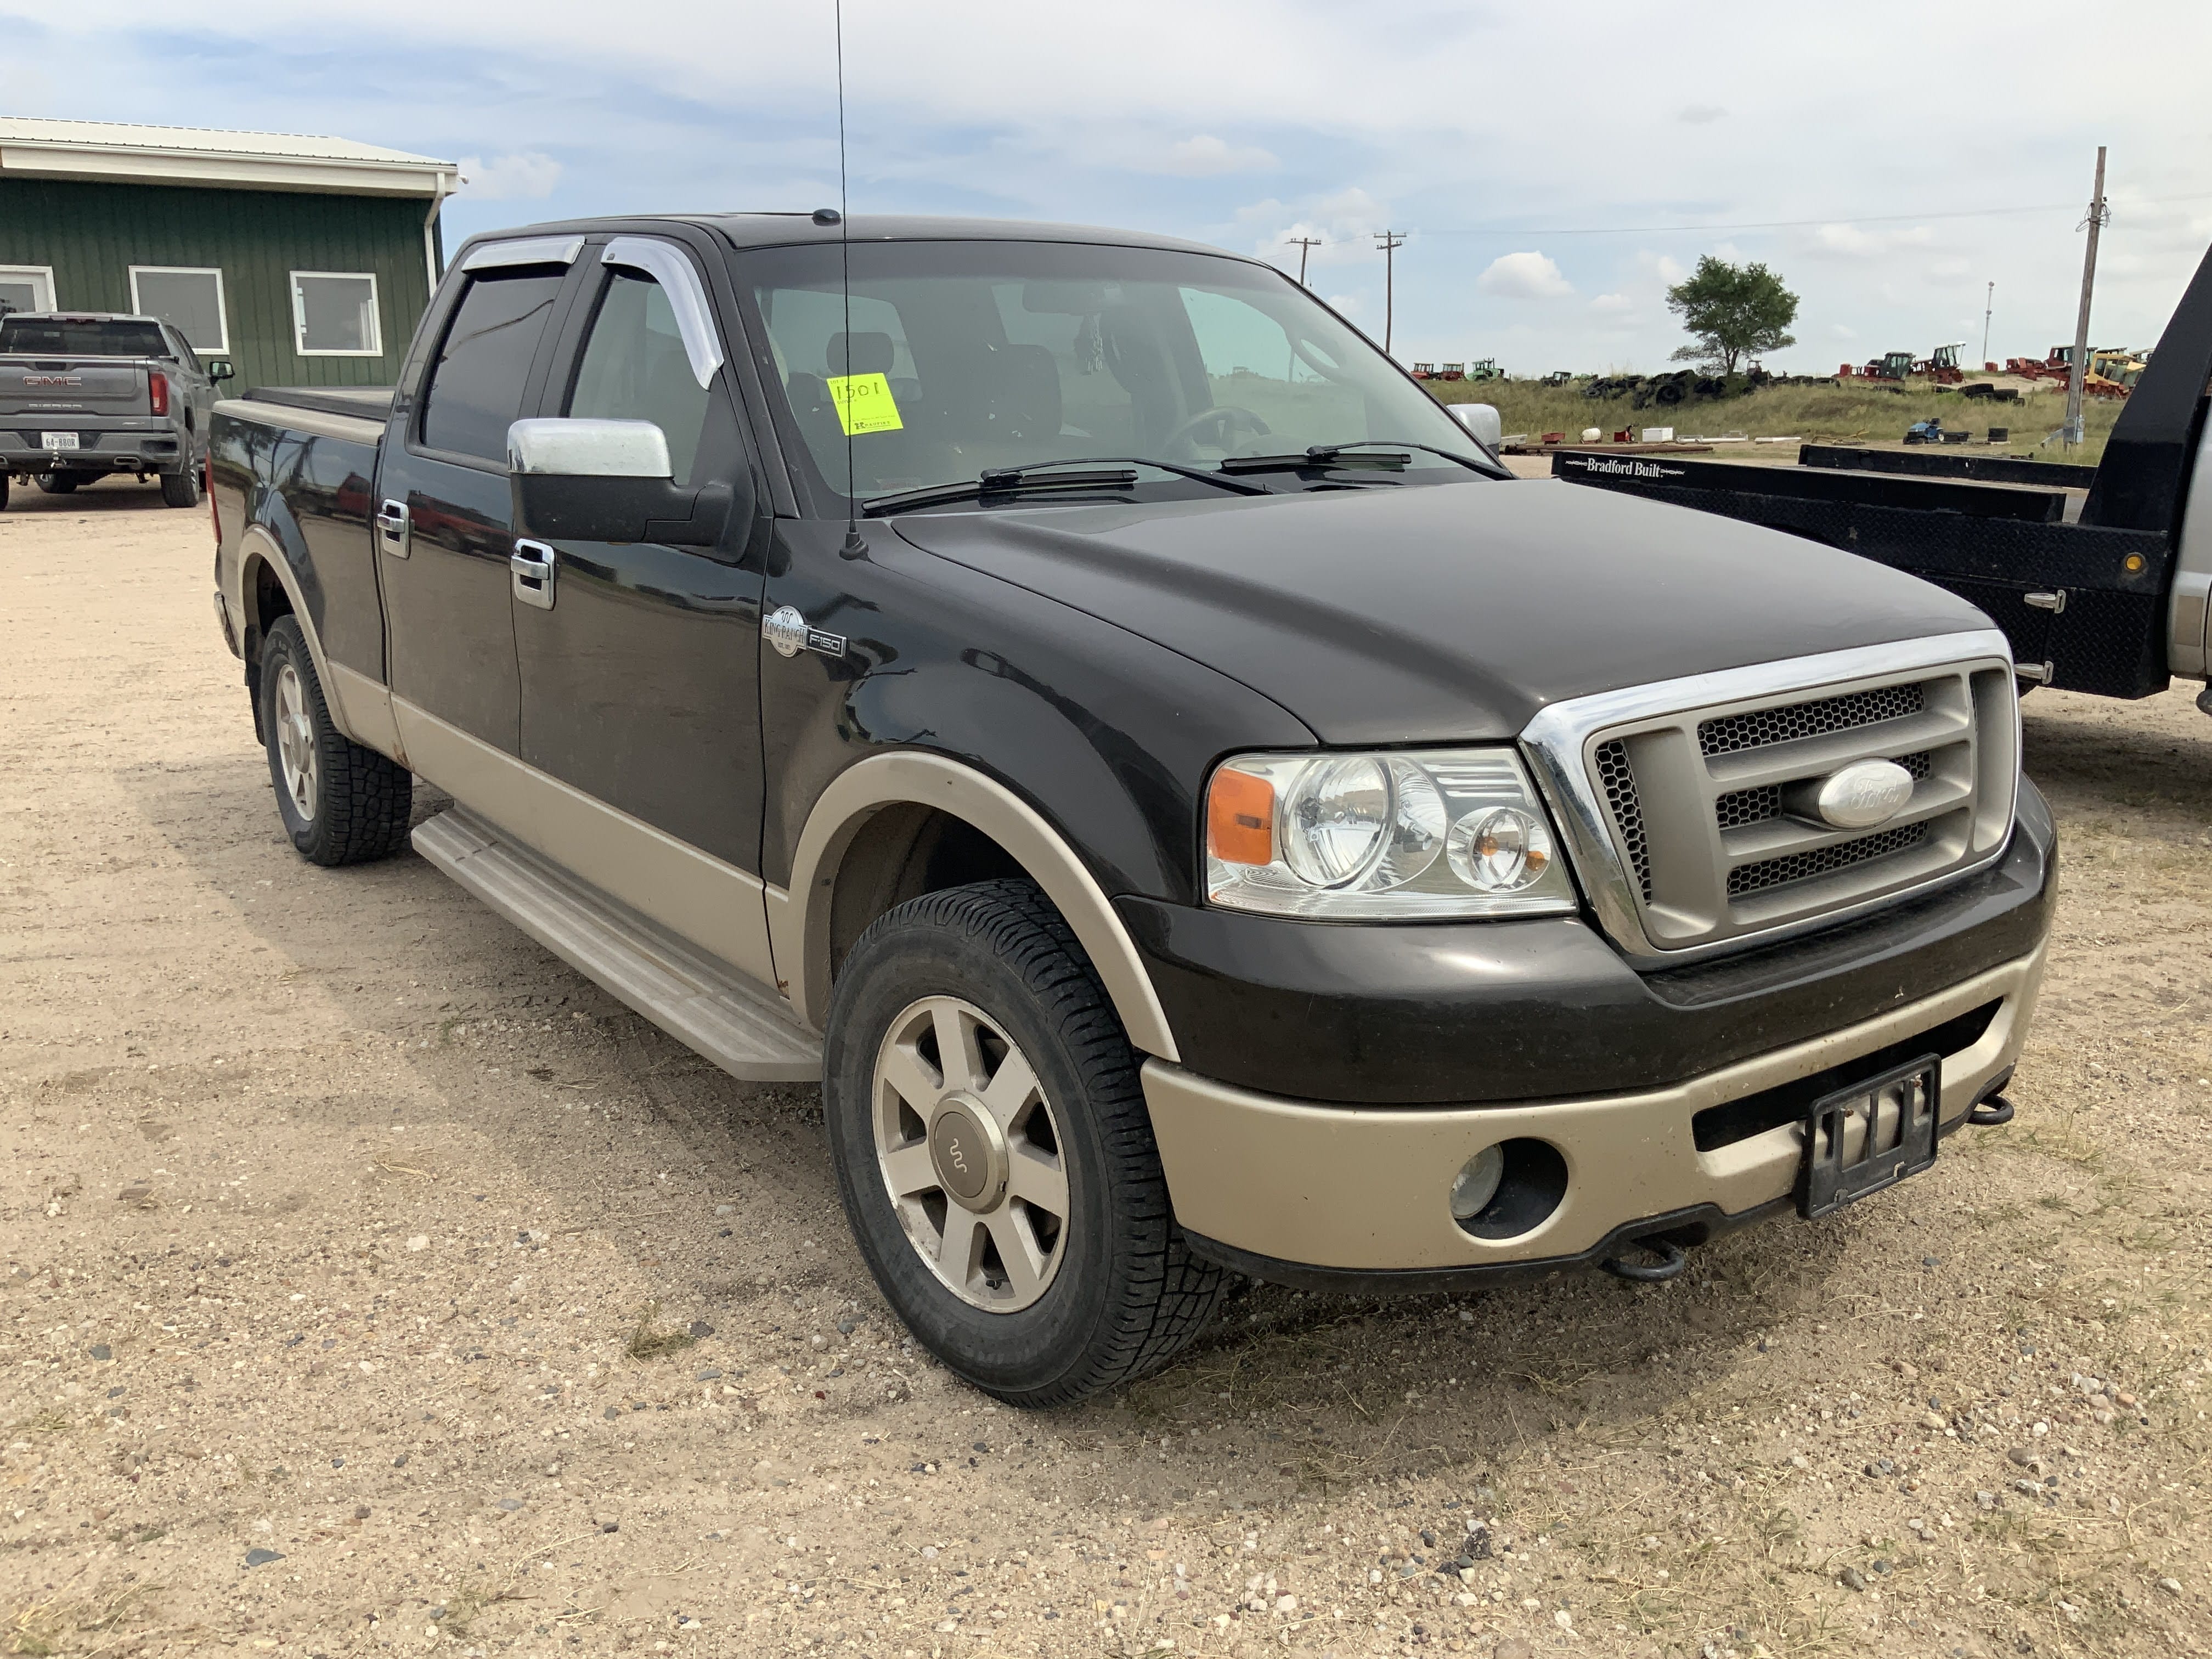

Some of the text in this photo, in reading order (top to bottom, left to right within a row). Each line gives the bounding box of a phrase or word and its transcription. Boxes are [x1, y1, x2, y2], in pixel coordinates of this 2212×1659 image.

[22, 376, 82, 387] GMC
[837, 382, 881, 400] 1501
[1587, 458, 1633, 475] Bradford
[764, 619, 805, 644] KING RANCH
[809, 634, 840, 651] F-150
[1850, 772, 1899, 810] Ford
